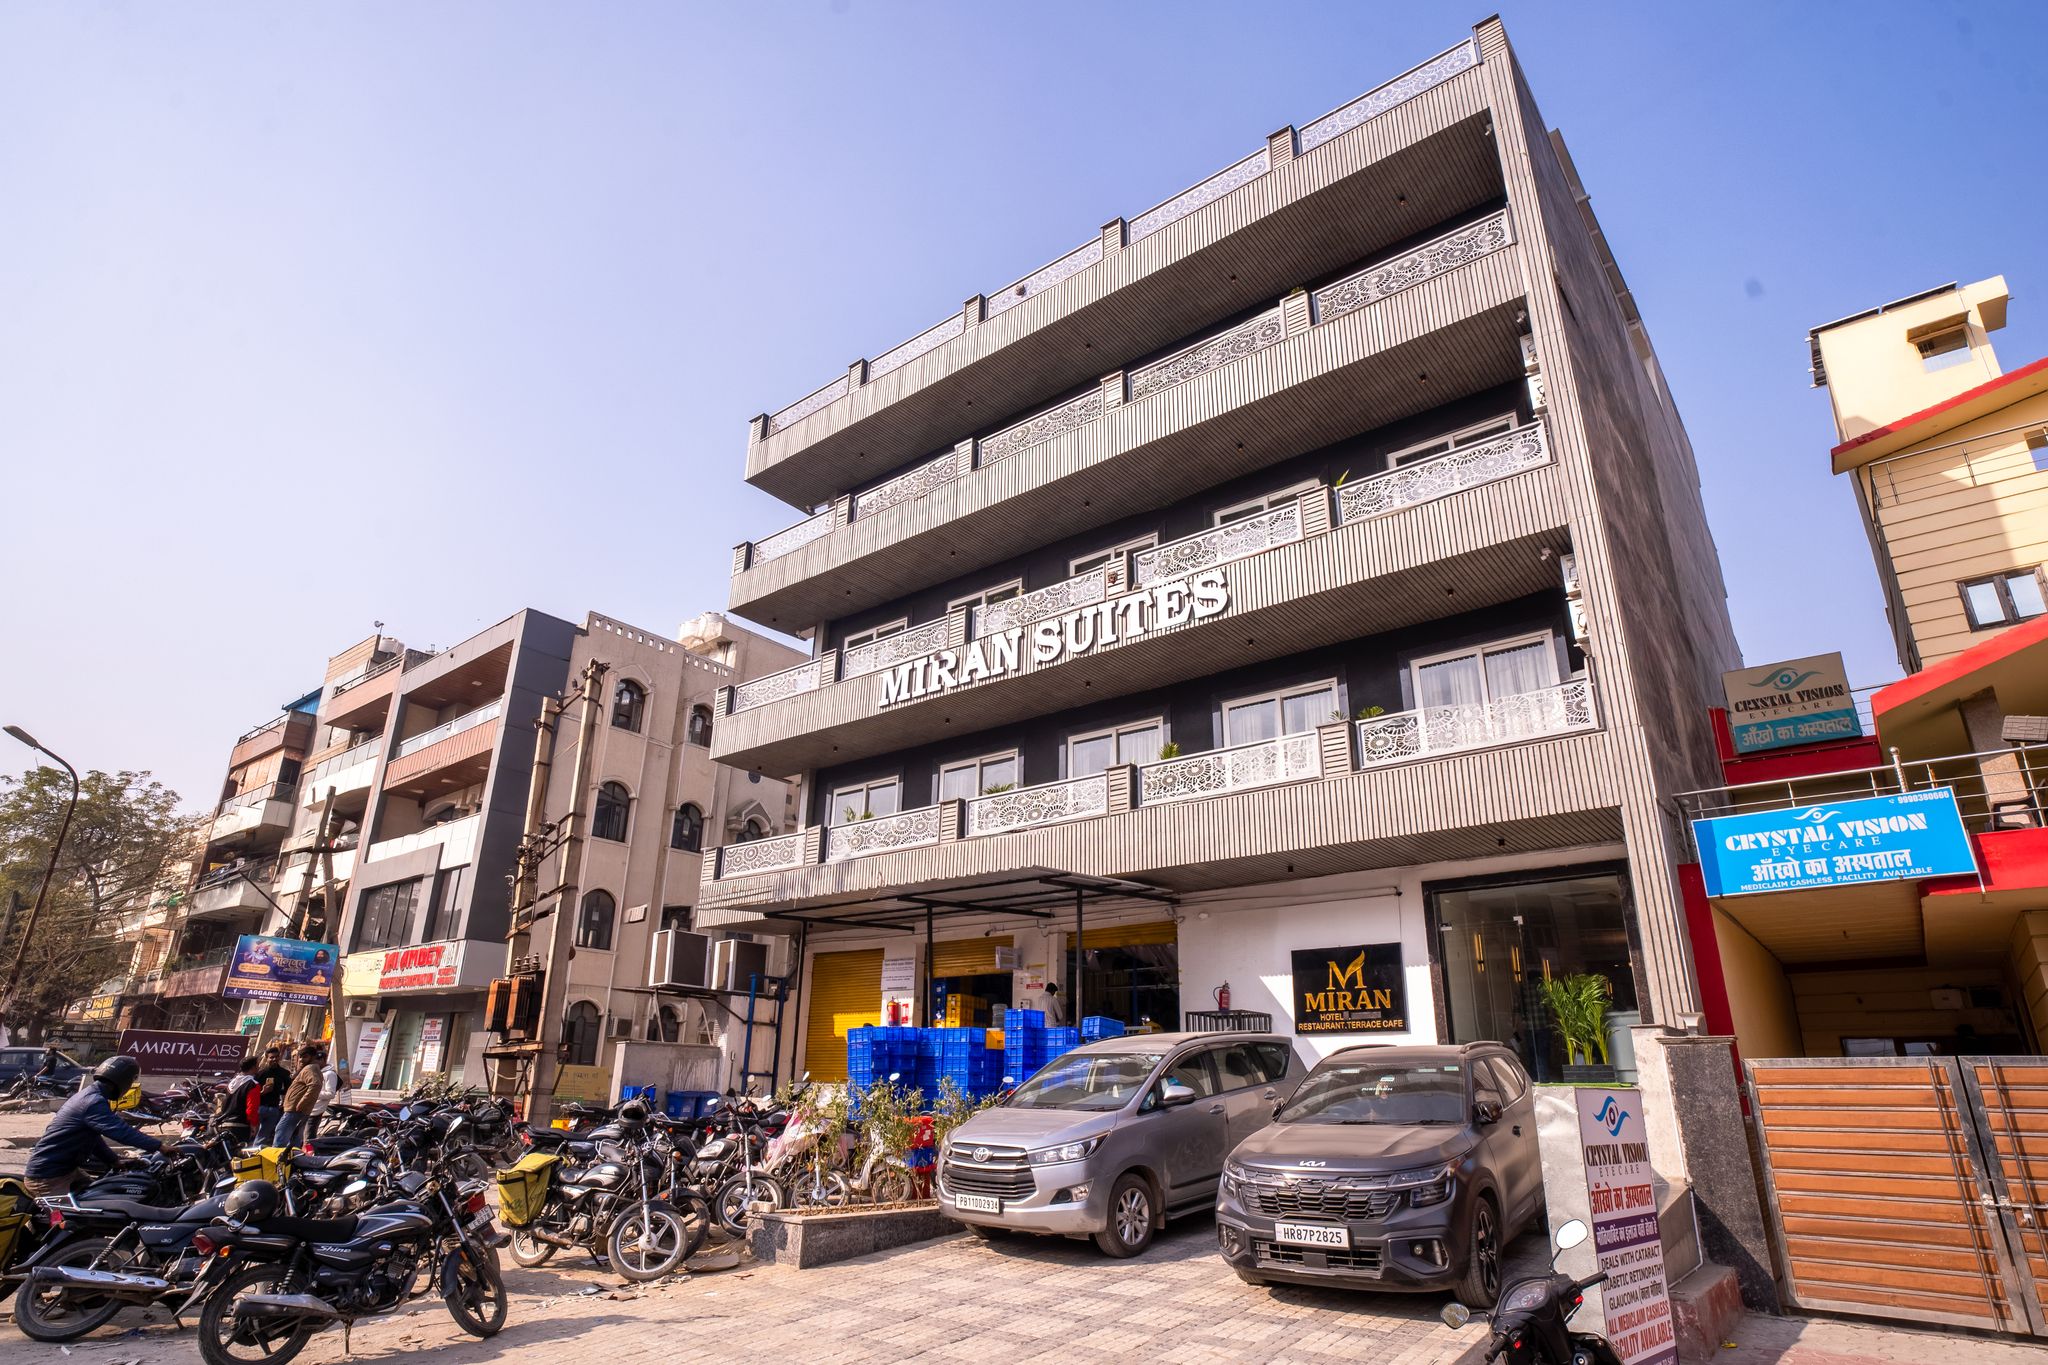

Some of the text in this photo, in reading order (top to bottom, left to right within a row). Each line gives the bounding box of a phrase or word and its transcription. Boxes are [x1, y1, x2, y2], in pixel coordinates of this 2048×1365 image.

[879, 569, 1231, 707] MIRAN SUITES
[1734, 684, 1845, 713] CRYSTAL VISION
[1776, 725, 1796, 740] का
[1798, 717, 1852, 736] अस्पताल
[1725, 813, 1928, 851] CRYSTAL VISION
[1803, 858, 1829, 876] का
[1832, 849, 1913, 873] अस्पताल
[1740, 867, 1933, 891] MEDICLAIM CASHLESS FACILITY AVAILABLE
[247, 989, 287, 998] AGGARWAL
[289, 993, 318, 1001] ESTATES
[1304, 989, 1392, 1012] MIRAN
[1320, 1013, 1344, 1021] HOTEL
[1382, 1019, 1404, 1028] CAFE
[126, 1041, 241, 1057] AMRITA LABS
[1585, 1142, 1648, 1167] CRYSTAL VISION
[1613, 1187, 1624, 1211] का
[1624, 1184, 1653, 1209] अस्पताल
[1283, 1227, 1343, 1244] HR87P2825
[319, 1245, 352, 1253] Shine
[1601, 1245, 1660, 1271] DEALS WITH CATARACT
[1603, 1262, 1664, 1292] DIABETIC RETINOPATHY
[1608, 1289, 1640, 1311] GLAUCOMA
[1608, 1300, 1670, 1337] ALL MEDICLAIM CASHLESS
[1640, 1319, 1673, 1352] AVAILABLE
